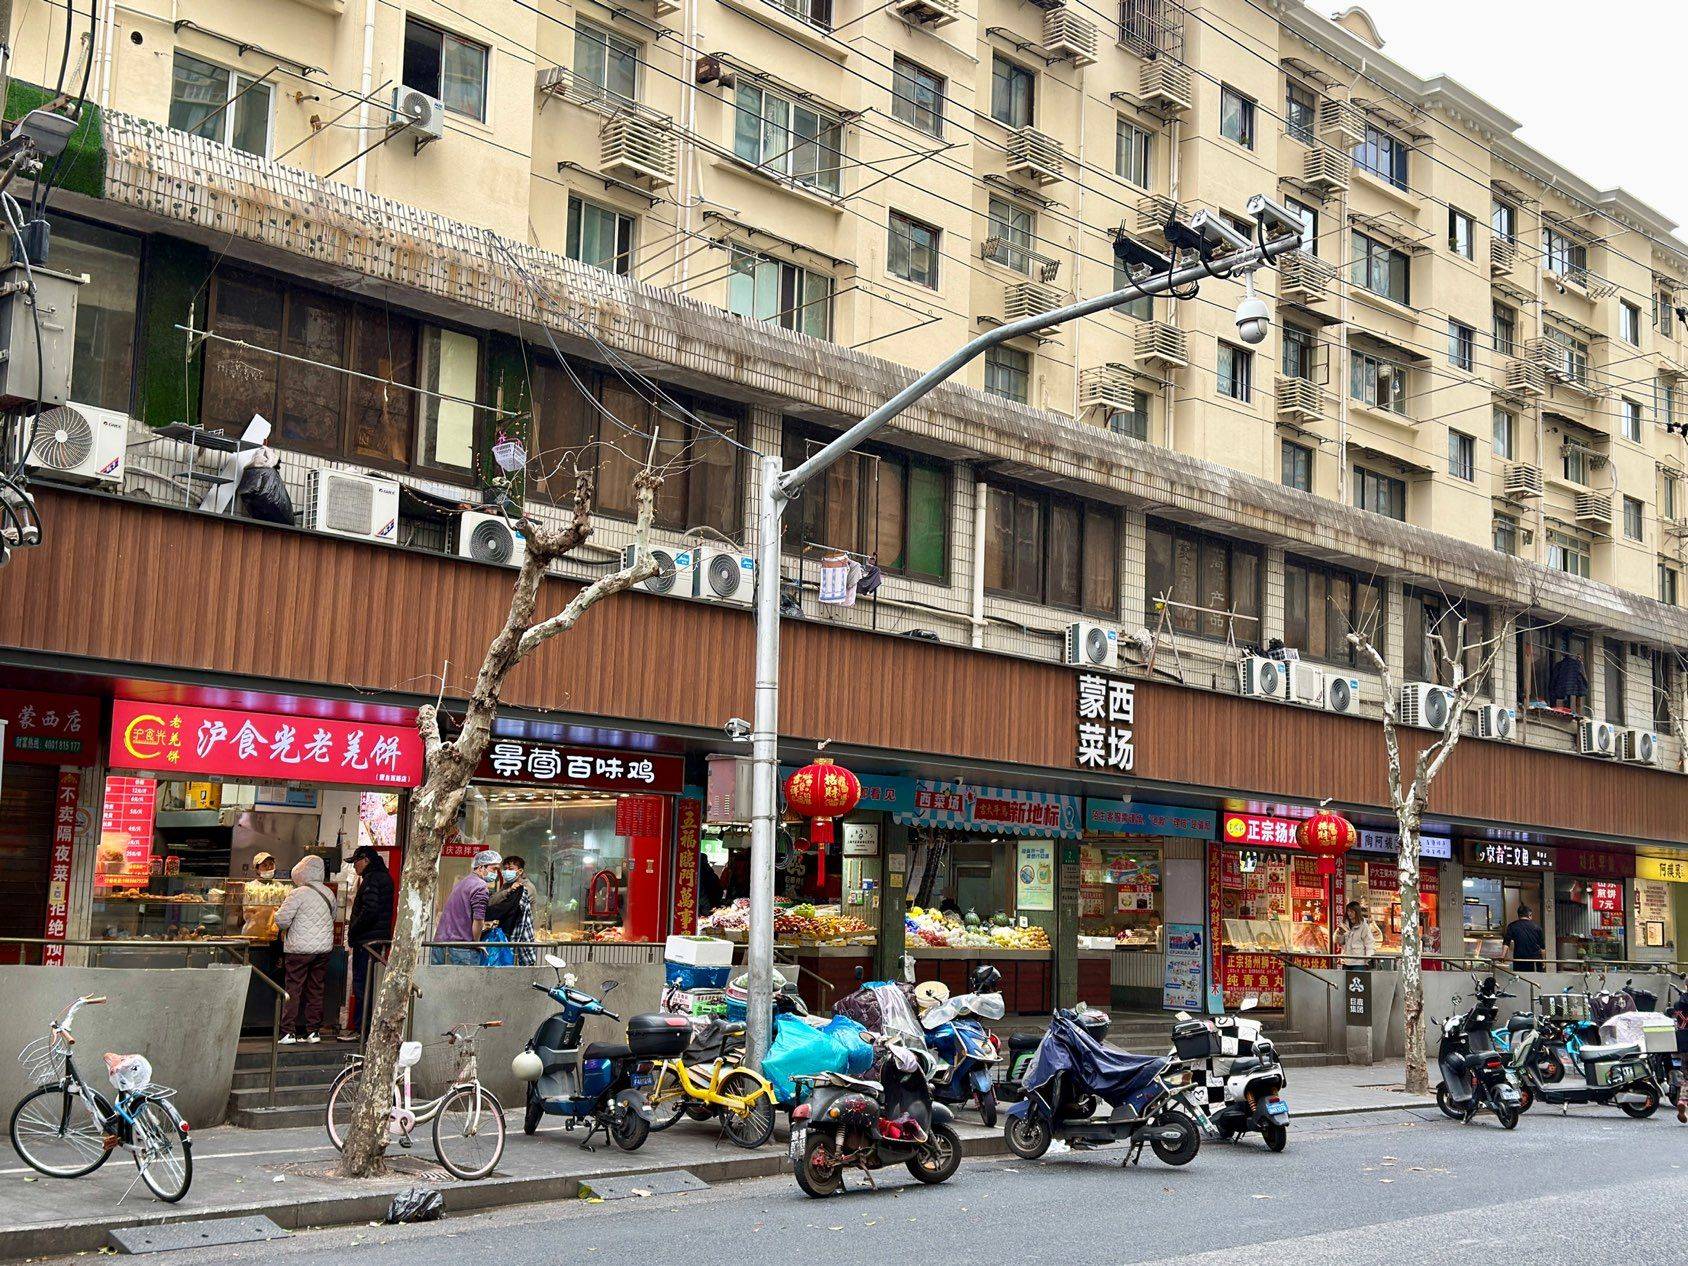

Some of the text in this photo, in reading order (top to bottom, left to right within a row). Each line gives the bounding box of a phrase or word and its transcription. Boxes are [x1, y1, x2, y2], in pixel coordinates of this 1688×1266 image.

[18, 705, 82, 732] 蒙西店
[1079, 674, 1135, 724] 蒙西
[1078, 722, 1135, 772] 菜场
[53, 787, 76, 881] 不卖隔夜菜
[1598, 900, 1614, 909] 7元
